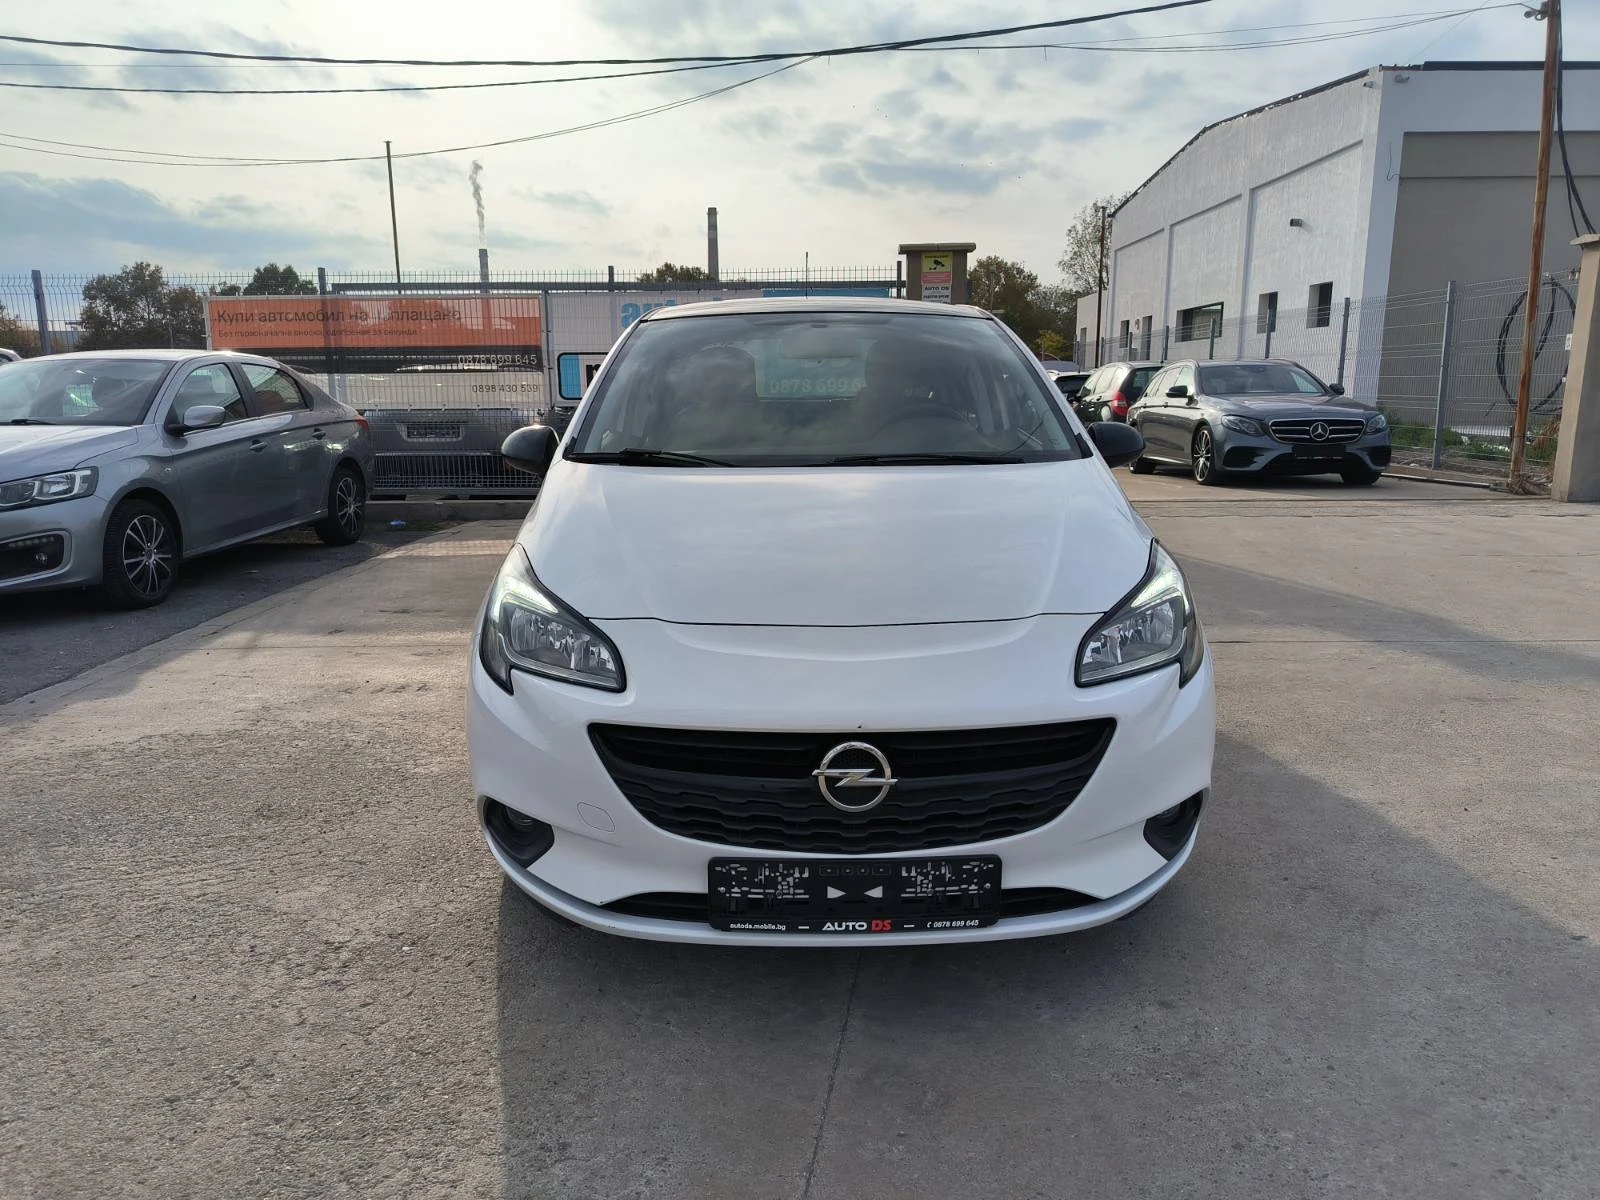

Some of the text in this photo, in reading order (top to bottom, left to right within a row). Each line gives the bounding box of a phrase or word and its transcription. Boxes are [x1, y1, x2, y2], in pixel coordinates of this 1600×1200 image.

[217, 310, 254, 326] Купи
[349, 311, 368, 321] на
[458, 354, 537, 366] 0878 699 645
[472, 384, 497, 393] 0898
[500, 384, 518, 393] 430
[822, 920, 892, 932] AUTO DS
